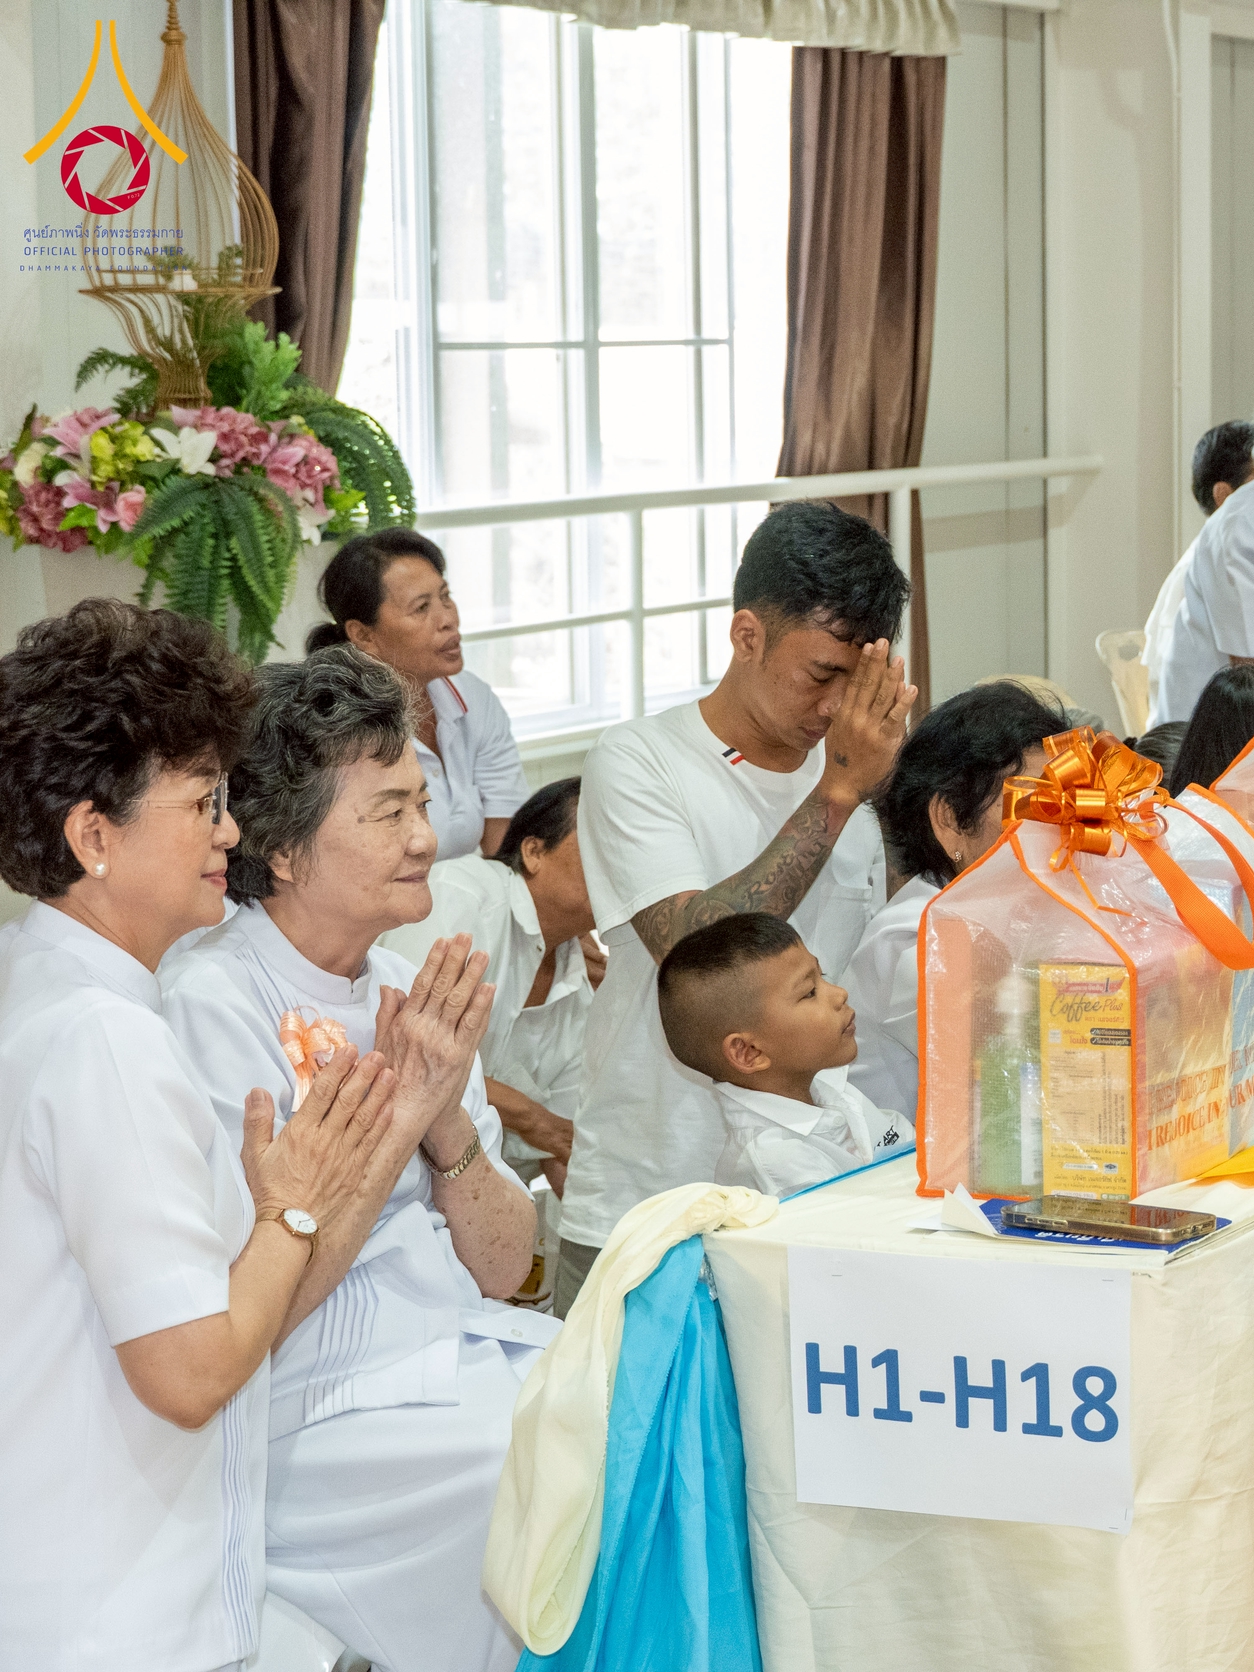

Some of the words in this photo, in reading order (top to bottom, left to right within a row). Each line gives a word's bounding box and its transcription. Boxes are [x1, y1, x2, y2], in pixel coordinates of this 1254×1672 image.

[1049, 991, 1102, 1023] Coffee
[1102, 998, 1124, 1012] Plus
[1155, 1105, 1206, 1149] REJOICE
[1207, 1101, 1221, 1124] IN
[804, 1342, 1119, 1443] H1-H18
